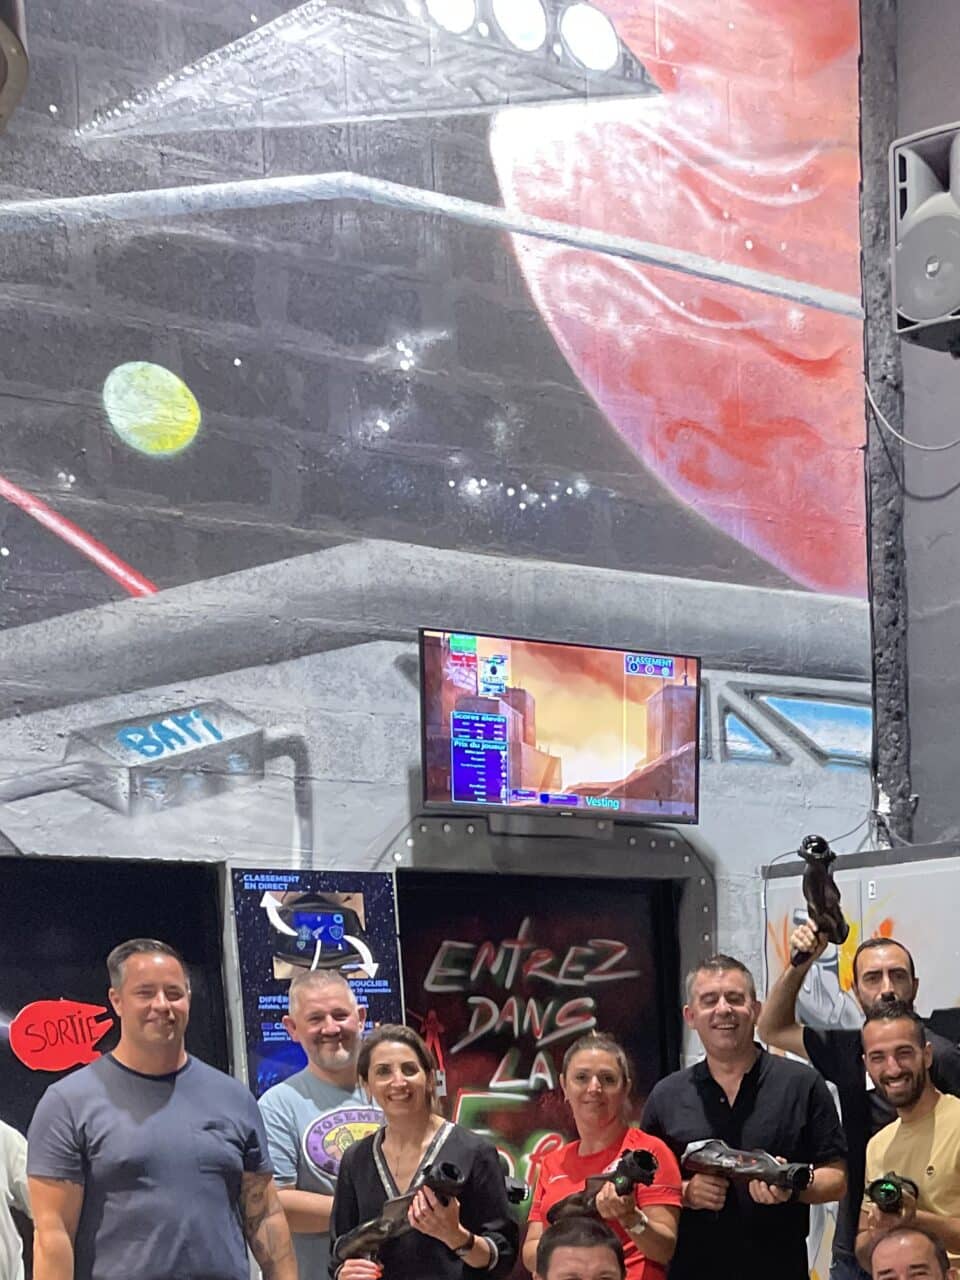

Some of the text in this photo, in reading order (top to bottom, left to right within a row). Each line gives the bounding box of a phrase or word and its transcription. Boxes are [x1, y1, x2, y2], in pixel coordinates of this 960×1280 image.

[243, 874, 300, 882] CLASSEMENT
[244, 882, 257, 890] EN
[449, 996, 597, 1054] DANS
[489, 1051, 554, 1091] LA
